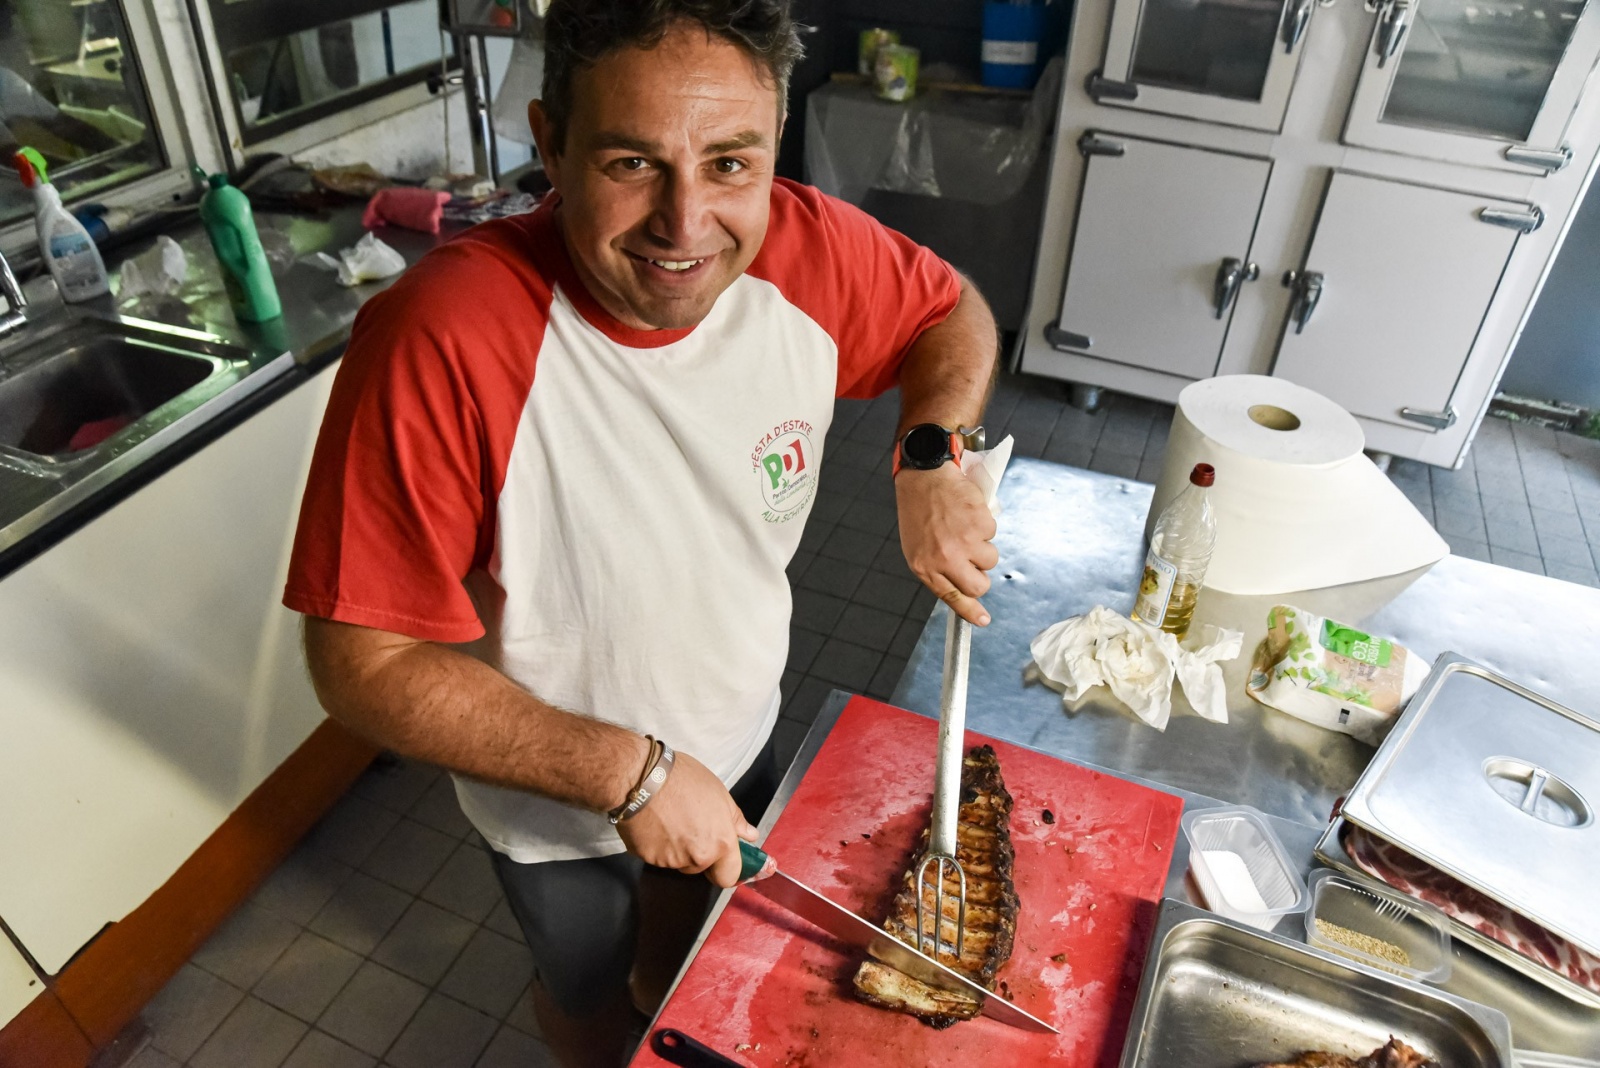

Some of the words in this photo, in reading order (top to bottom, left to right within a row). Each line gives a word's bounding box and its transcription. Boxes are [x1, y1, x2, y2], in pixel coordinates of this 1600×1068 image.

[773, 419, 813, 436] D'ESTATE
[761, 510, 780, 523] ALLA
[1352, 640, 1369, 660] ECO
[627, 788, 651, 812] INTER
